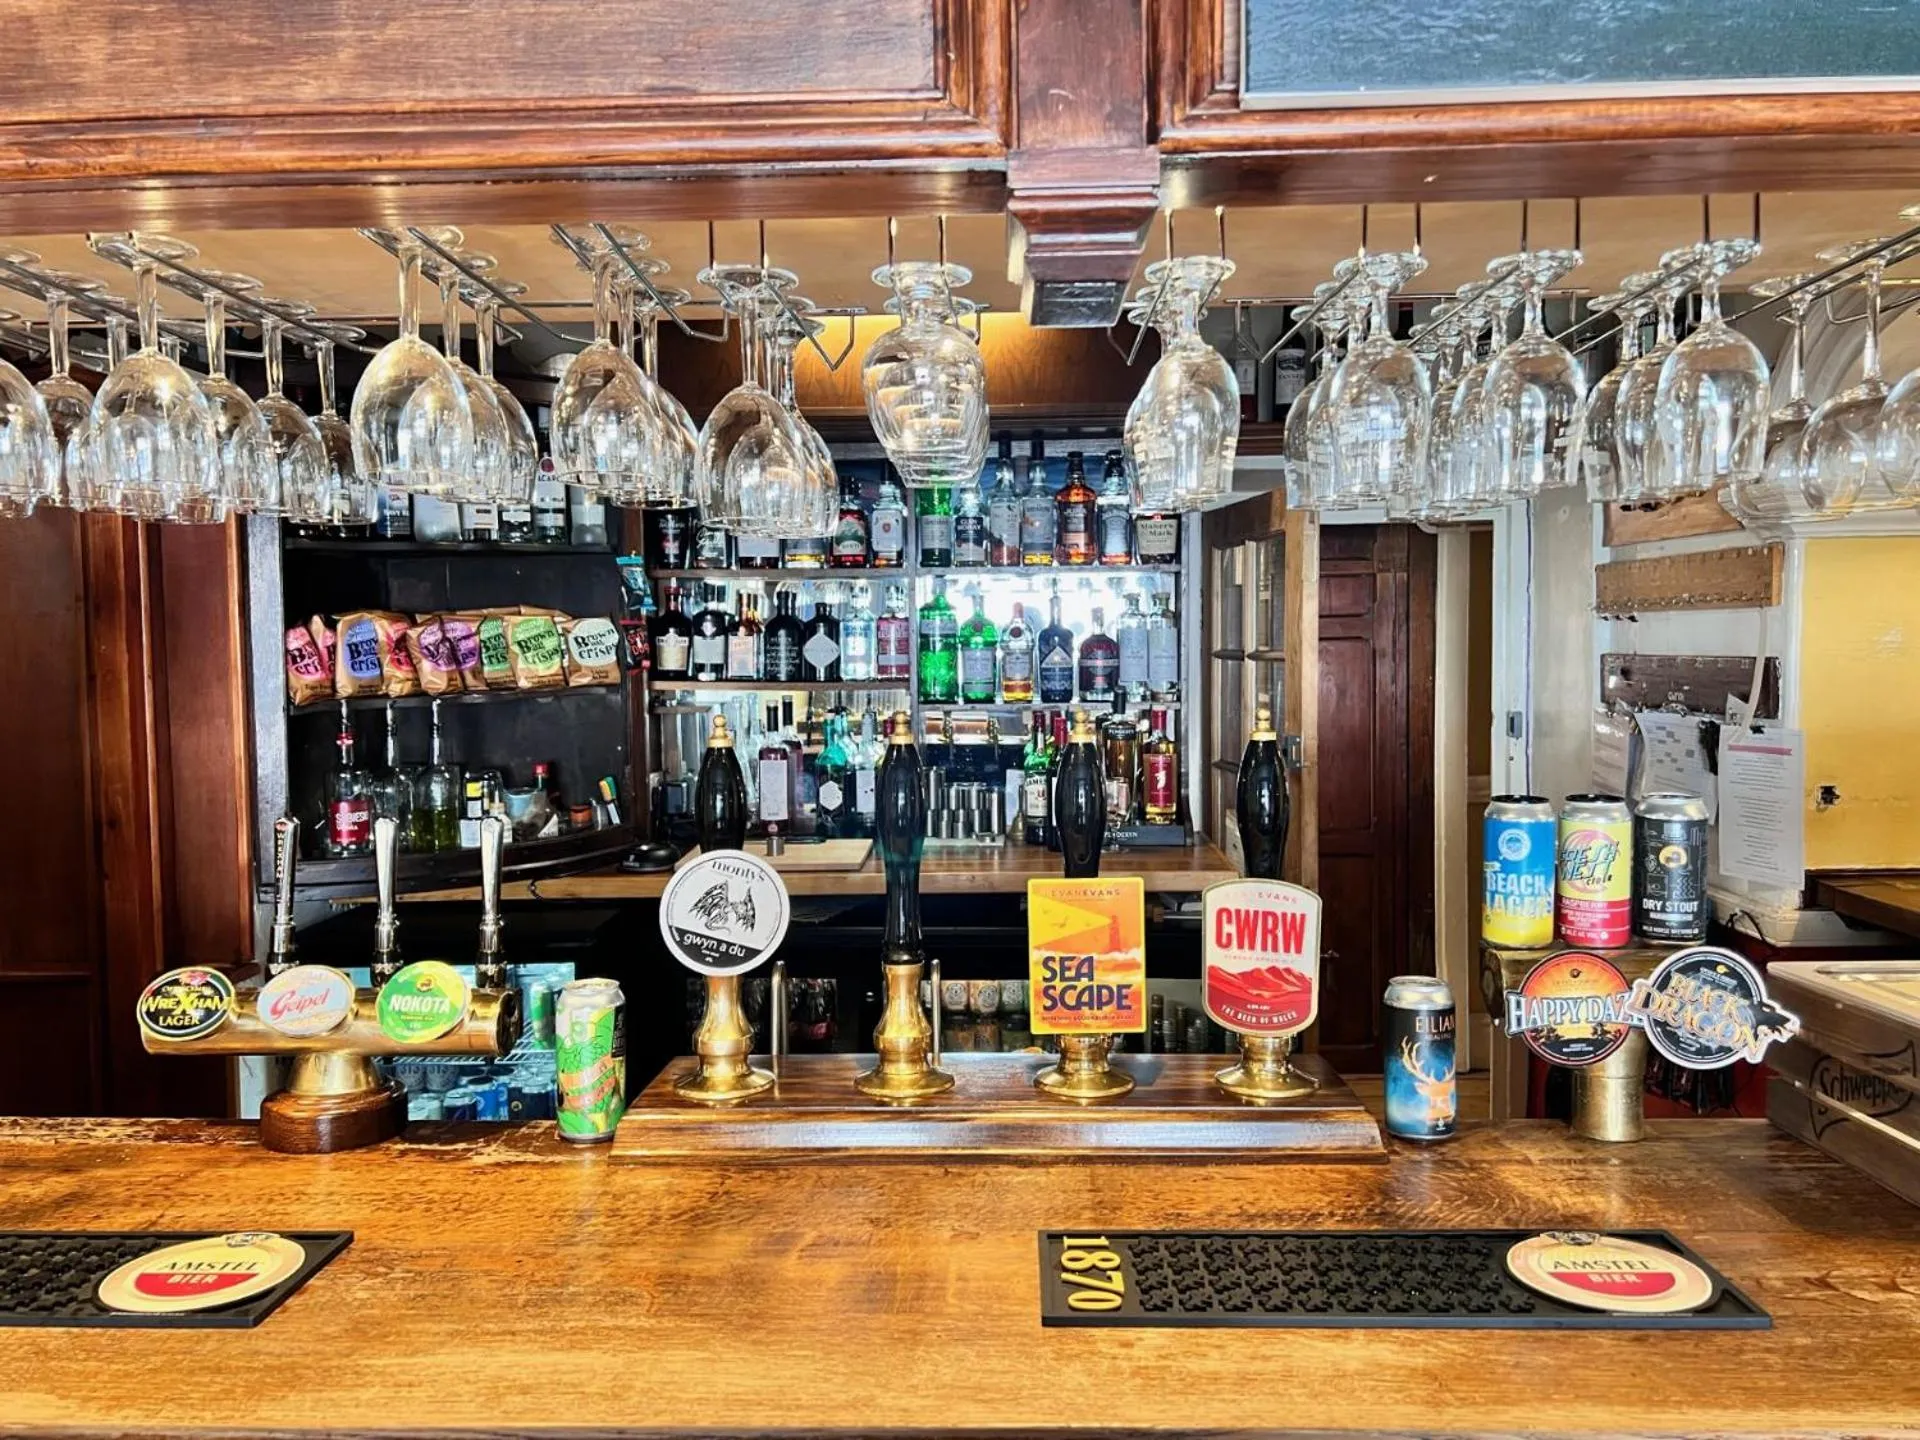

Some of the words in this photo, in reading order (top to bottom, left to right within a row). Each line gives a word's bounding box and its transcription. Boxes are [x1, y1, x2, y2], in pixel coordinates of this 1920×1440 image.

[346, 638, 378, 661] Brow
[573, 628, 615, 650] Brown
[350, 656, 378, 673] cris
[1486, 871, 1546, 896] BEACH
[1642, 898, 1664, 911] DRY
[1664, 900, 1699, 913] STOUT
[1215, 907, 1308, 955] CWRW
[683, 933, 718, 951] gwyn
[719, 943, 727, 952] a
[728, 943, 746, 958] du
[1041, 955, 1094, 983] SEA
[141, 991, 230, 1016] WREXHAM
[389, 995, 452, 1014] NOKOTA
[1042, 984, 1134, 1012] SCAPE
[158, 1014, 201, 1027] LAGER
[1508, 994, 1584, 1034] HAPPY
[1585, 992, 1646, 1027] DAZ
[158, 1260, 260, 1272] AMSTEL
[1060, 1235, 1125, 1311] 1870
[1552, 1258, 1657, 1271] AMSTEL
[166, 1274, 219, 1285] BIER
[1586, 1273, 1643, 1284] BIER
